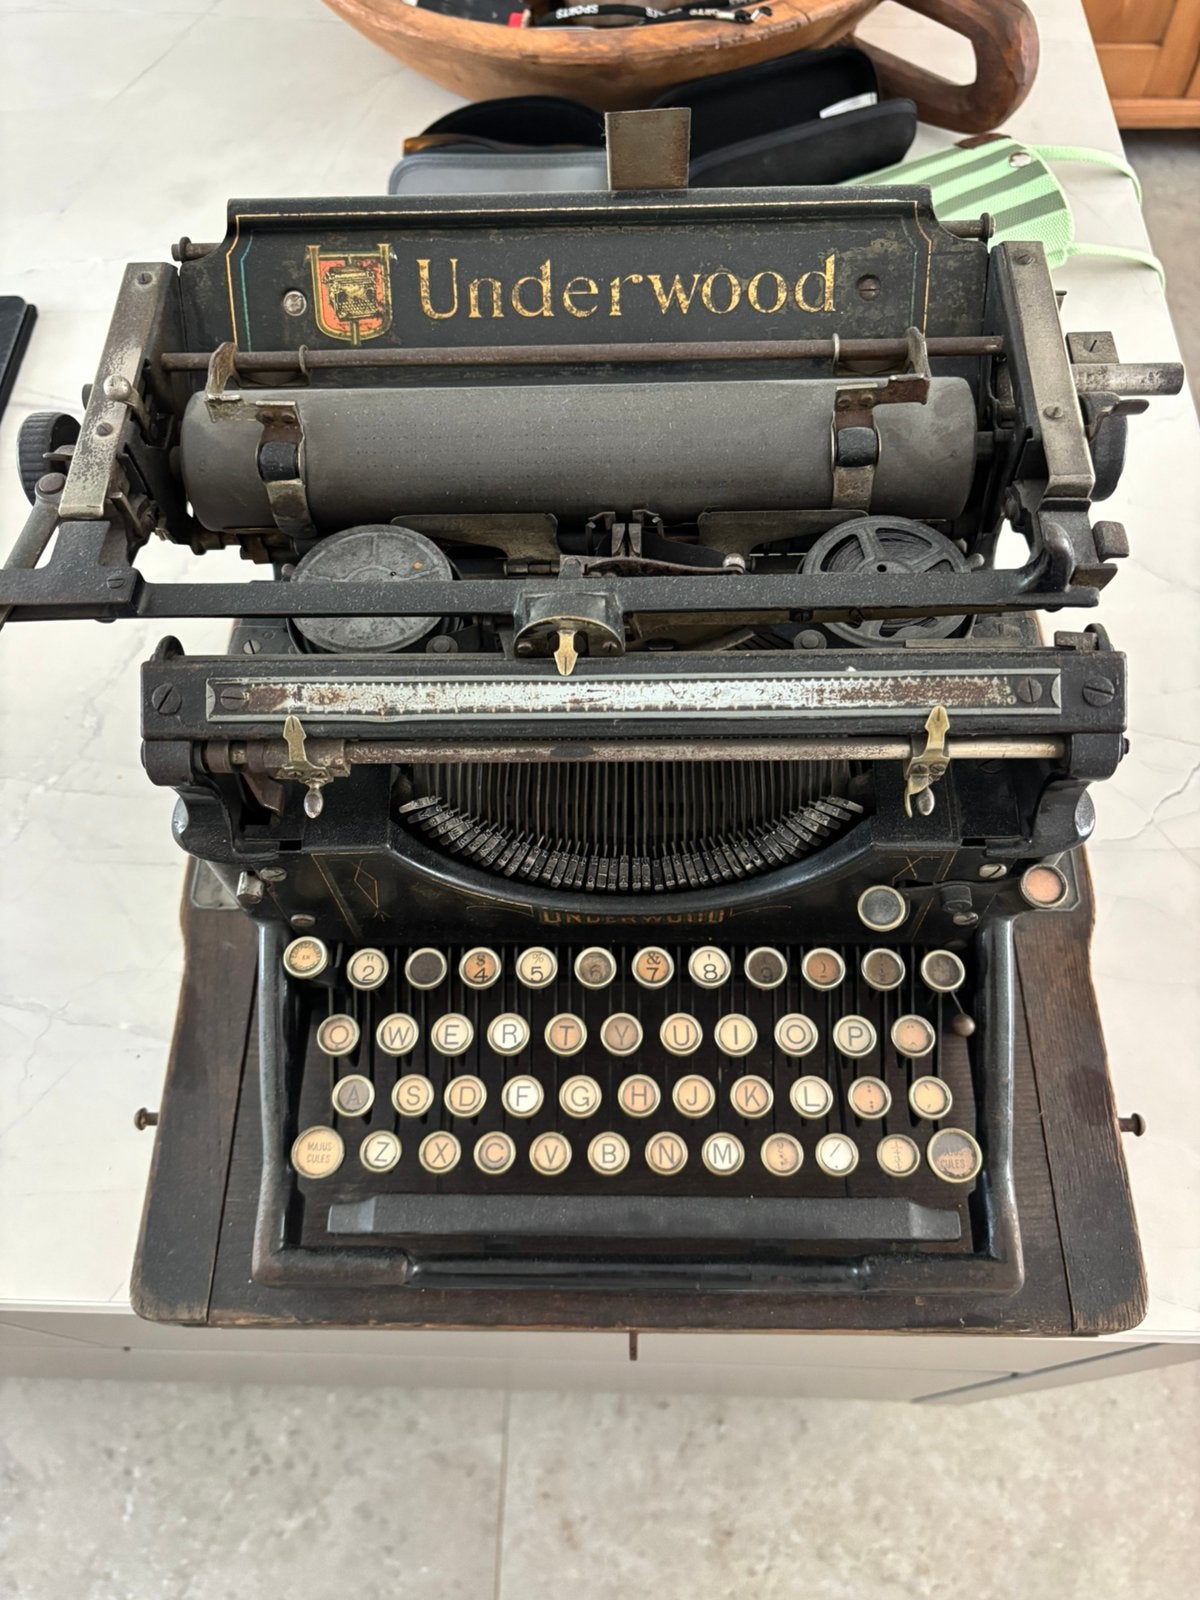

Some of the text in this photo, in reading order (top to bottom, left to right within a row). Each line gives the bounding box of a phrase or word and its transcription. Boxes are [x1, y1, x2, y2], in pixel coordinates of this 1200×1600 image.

[416, 254, 836, 321] Underwood
[646, 952, 661, 965] &
[362, 965, 375, 982] 2
[473, 967, 489, 983] 4
[530, 966, 544, 982] 5
[646, 967, 660, 982] 7
[703, 963, 718, 980] 8
[761, 966, 774, 982] 9
[388, 1026, 411, 1046] W
[444, 1024, 460, 1045] E
[502, 1024, 518, 1043] R
[559, 1025, 575, 1045] T
[614, 1025, 630, 1045] Y
[673, 1025, 690, 1046] U
[786, 1024, 806, 1044] O
[848, 1026, 864, 1046] P
[349, 1085, 363, 1105] A
[407, 1085, 421, 1106] S
[459, 1086, 477, 1106] D
[516, 1086, 532, 1106] F
[570, 1086, 590, 1107] G
[631, 1085, 648, 1106] H
[686, 1086, 698, 1106] J
[744, 1086, 761, 1107] K
[804, 1086, 820, 1107] L
[374, 1142, 390, 1162] Z
[432, 1142, 449, 1163] X
[486, 1142, 504, 1163] C
[544, 1144, 559, 1165] V
[602, 1143, 617, 1163] B
[659, 1143, 675, 1165] N
[713, 1143, 732, 1164] M
